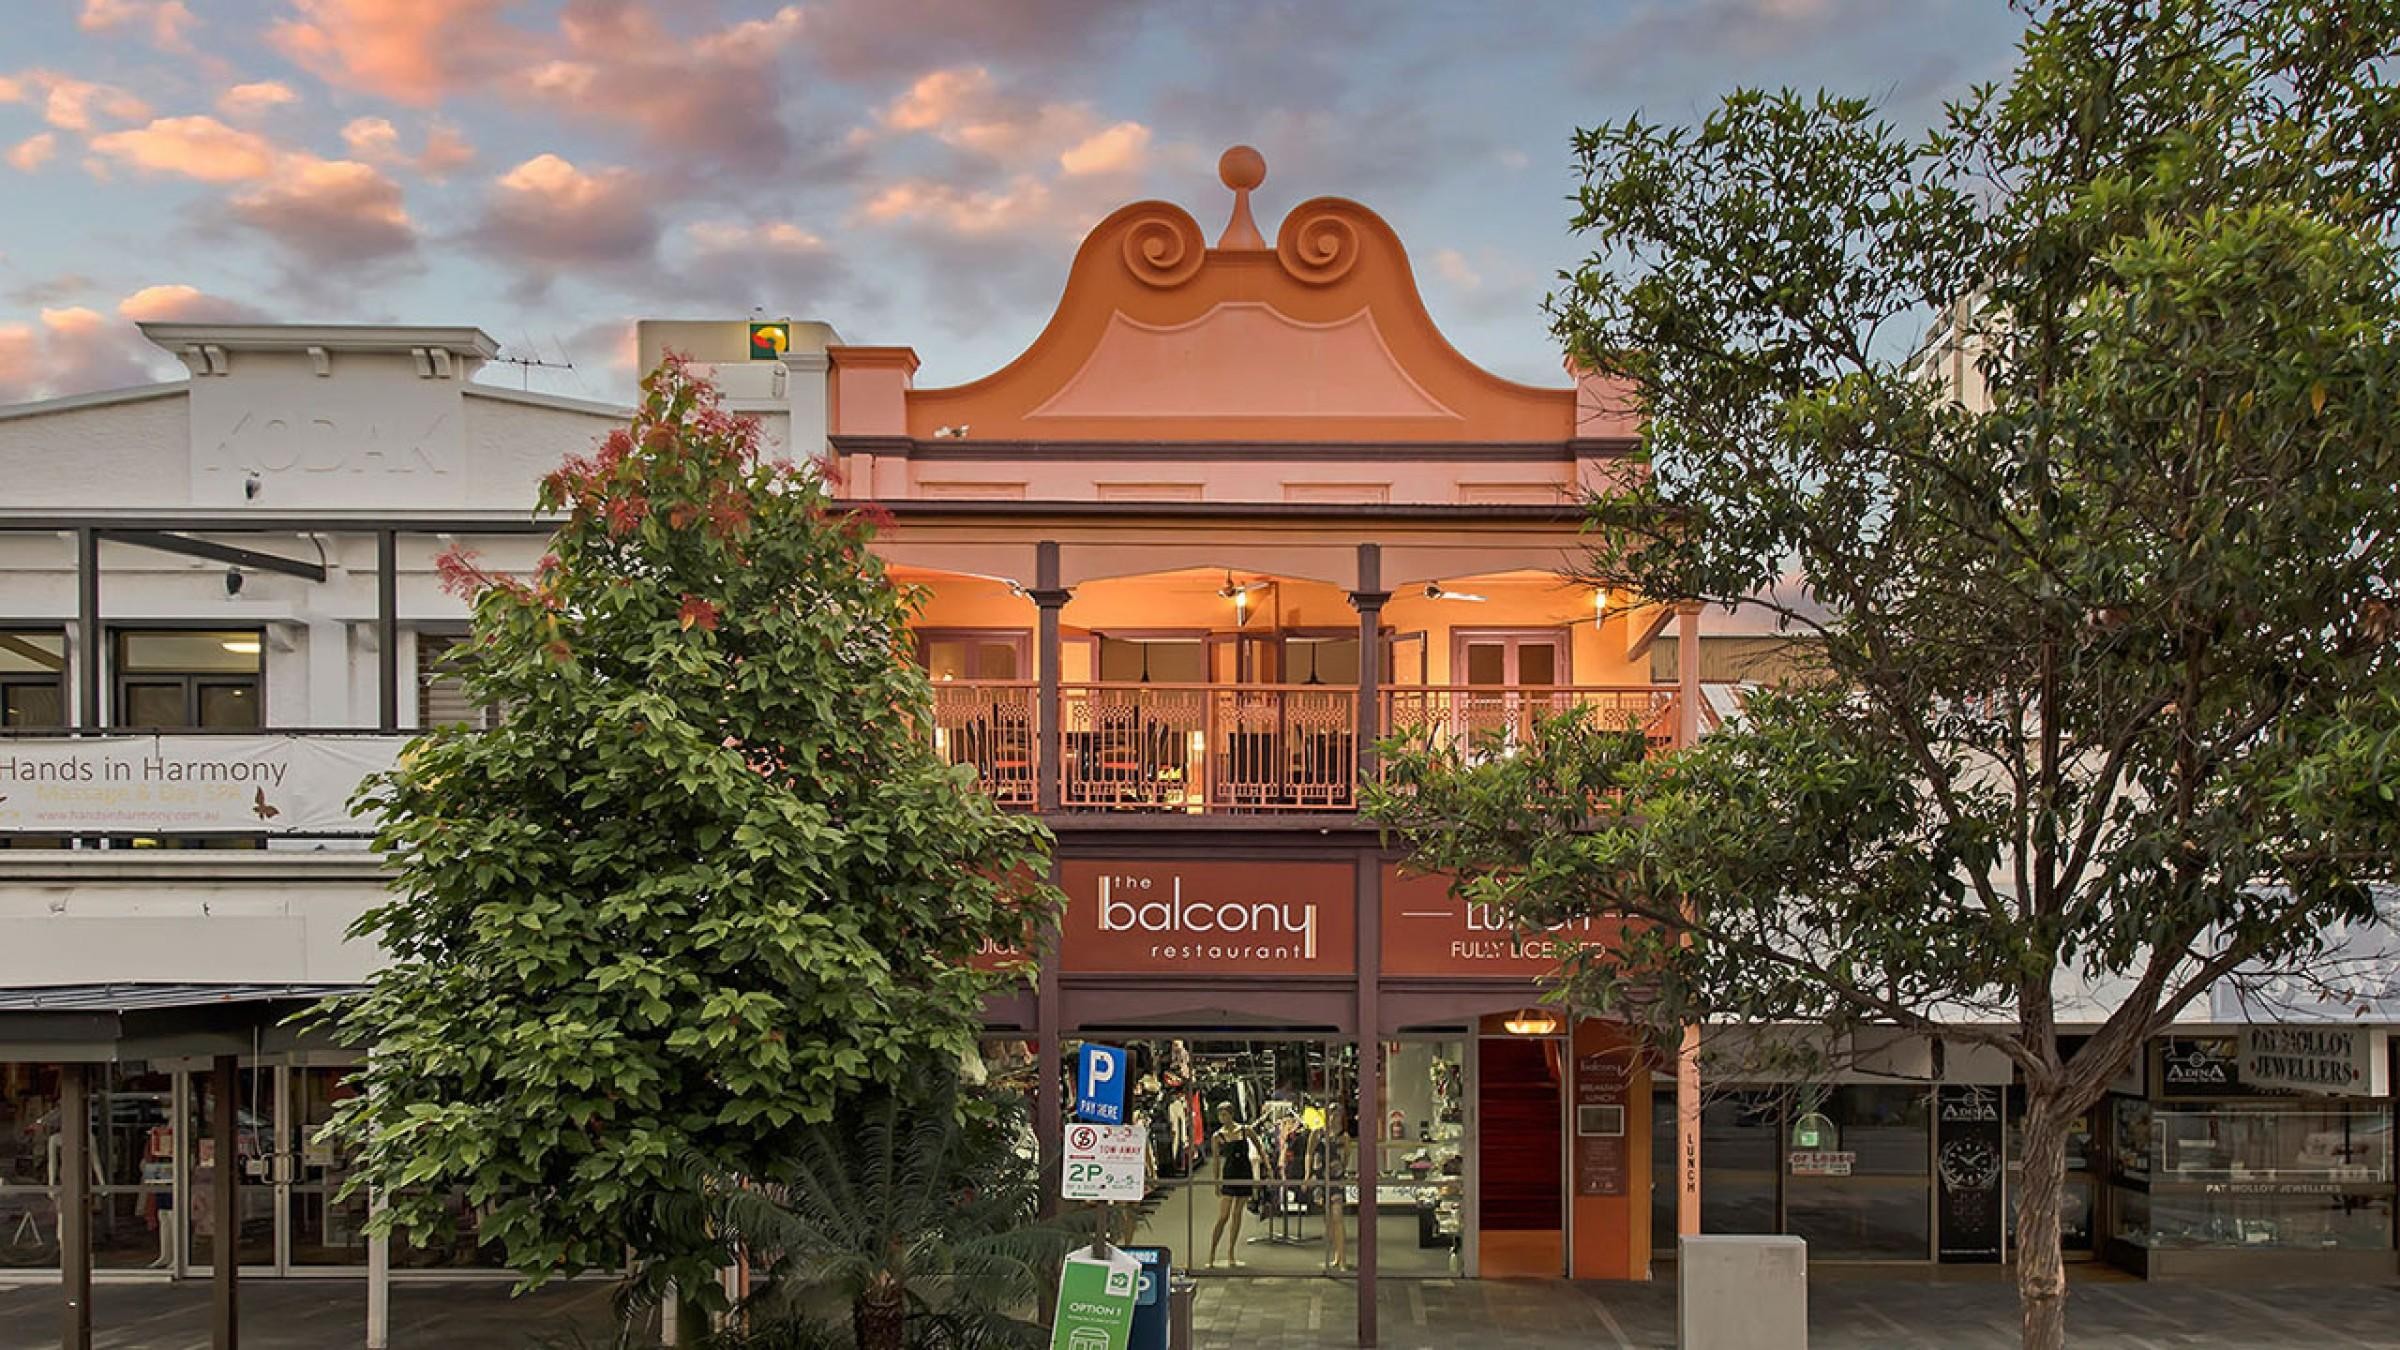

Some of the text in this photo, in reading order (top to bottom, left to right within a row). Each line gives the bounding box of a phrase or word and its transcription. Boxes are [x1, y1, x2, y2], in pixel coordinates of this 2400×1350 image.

[204, 411, 449, 474] KODAK
[0, 756, 288, 787] Hands in Harmony
[1114, 876, 1152, 889] the
[1098, 876, 1317, 958] balcony
[1151, 943, 1301, 959] restaurant
[1451, 940, 1504, 958] FULLY
[1088, 1049, 1115, 1097] P
[2255, 1055, 2352, 1083] JEWELLERS
[1069, 1163, 1103, 1182] 2P
